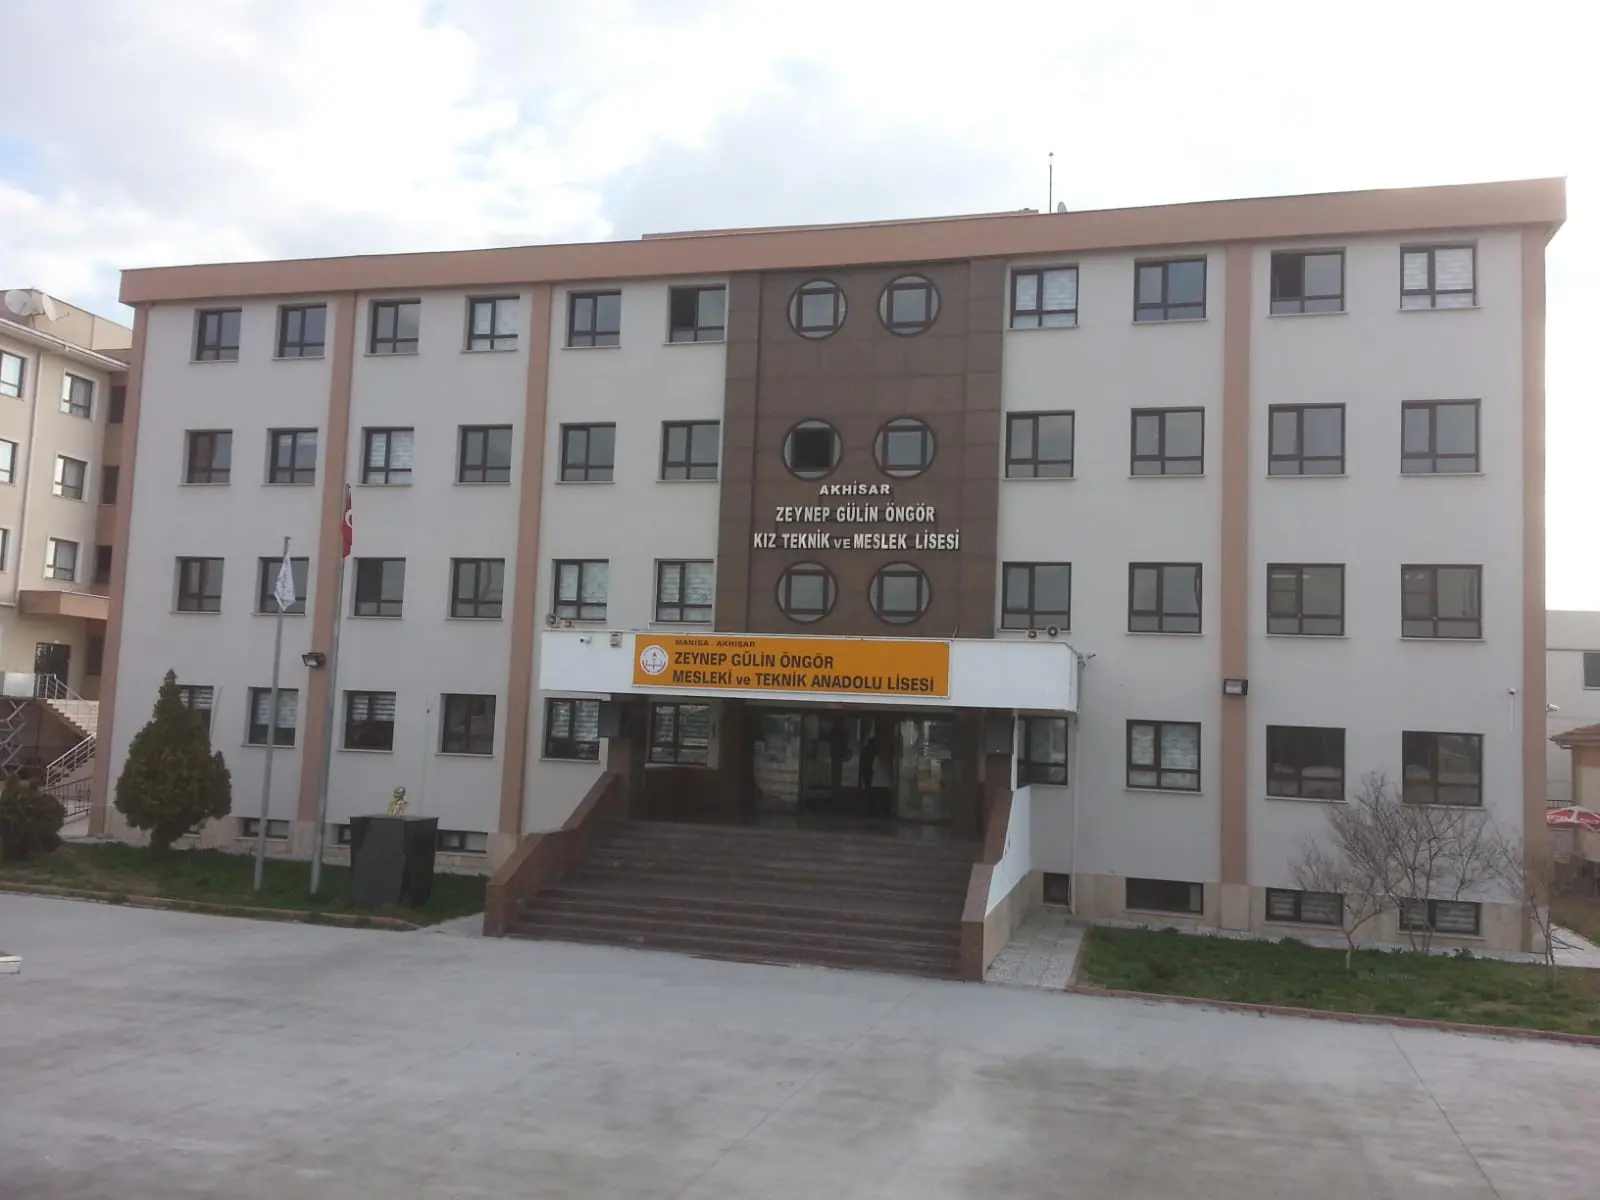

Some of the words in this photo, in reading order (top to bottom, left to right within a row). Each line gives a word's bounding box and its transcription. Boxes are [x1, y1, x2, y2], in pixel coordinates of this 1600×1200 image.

[820, 481, 890, 495] AKHİSAR
[776, 506, 830, 522] ZEYNEP
[836, 501, 878, 522] GÜLİN
[885, 502, 935, 522] ÖNGÖR
[753, 532, 777, 548] KIZ
[781, 529, 830, 549] TEKNİK
[853, 533, 907, 550] MESLEK
[915, 529, 959, 550] LİSESİ
[674, 651, 727, 666] ZEYNEP
[731, 650, 775, 668] GÜLİN
[780, 652, 834, 669] ÖNGÖR
[672, 669, 732, 685] MESLEKİ
[736, 675, 750, 685] ve
[755, 671, 806, 687] TEKNİK
[811, 674, 882, 690] ANADOLU
[887, 674, 934, 692] LİSESİ
